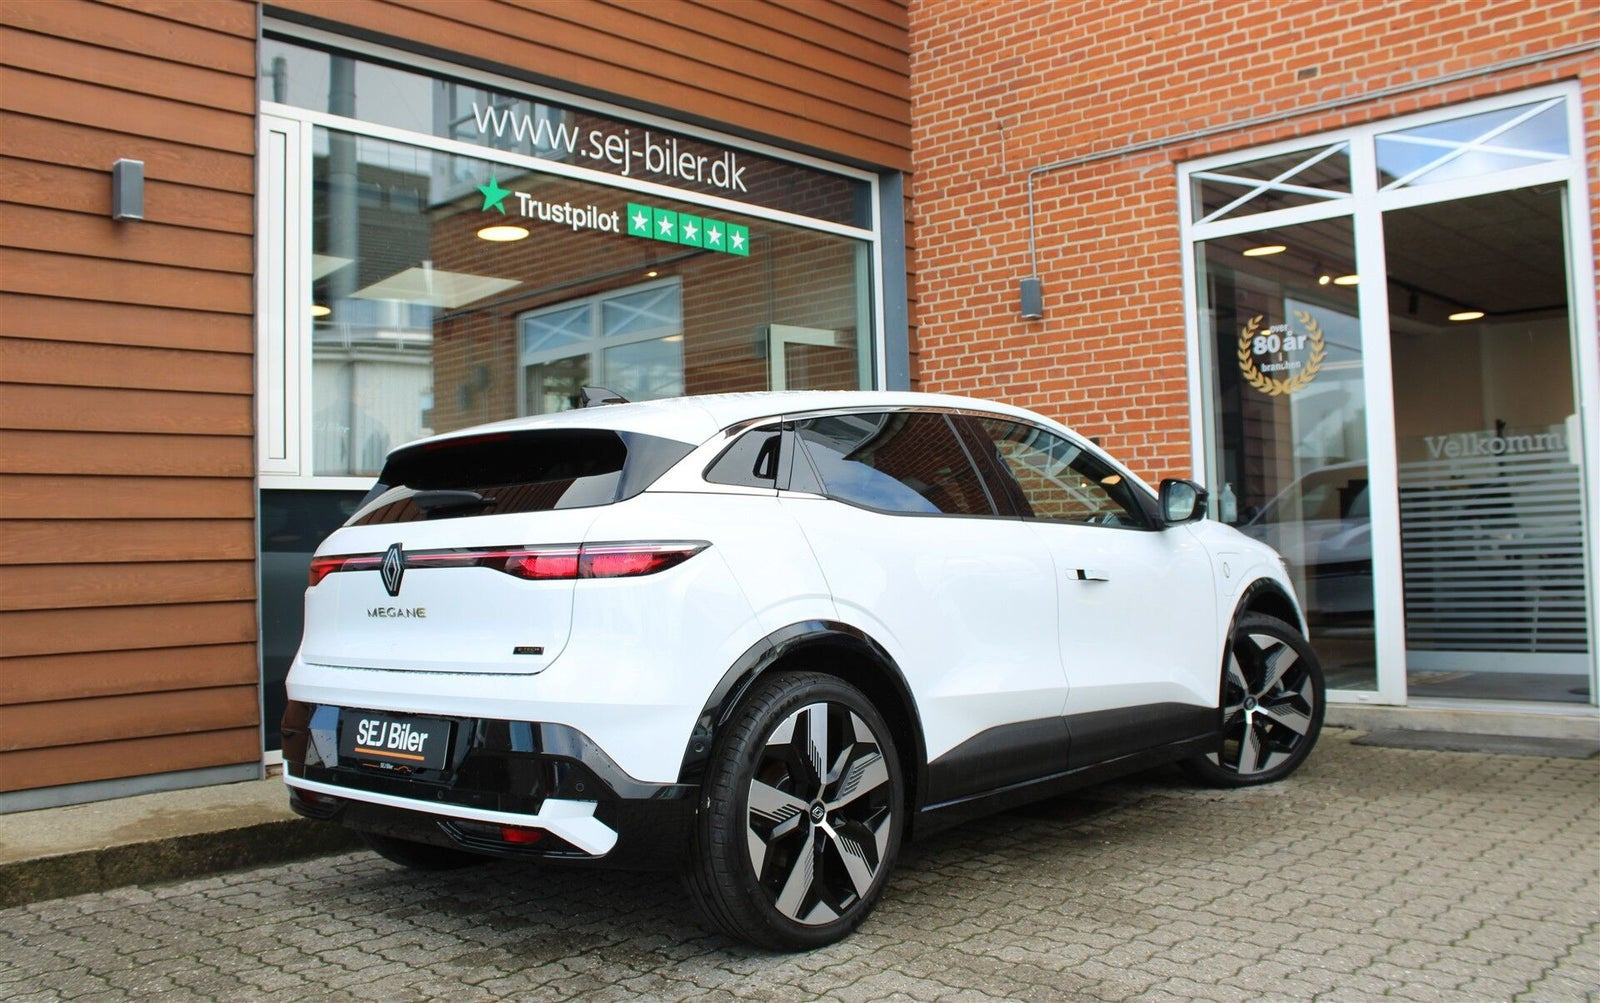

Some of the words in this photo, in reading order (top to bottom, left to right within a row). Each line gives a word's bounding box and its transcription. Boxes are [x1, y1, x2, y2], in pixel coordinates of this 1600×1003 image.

[472, 102, 748, 192] www.sej-biler.dk
[514, 191, 620, 233] Trustpilot
[1270, 324, 1288, 333] over
[1252, 334, 1281, 355] 80
[1283, 330, 1307, 352] år
[1424, 432, 1566, 459] Velkomm
[367, 607, 427, 618] MEGANE
[356, 719, 387, 747] SEJ
[387, 722, 429, 752] Biler
